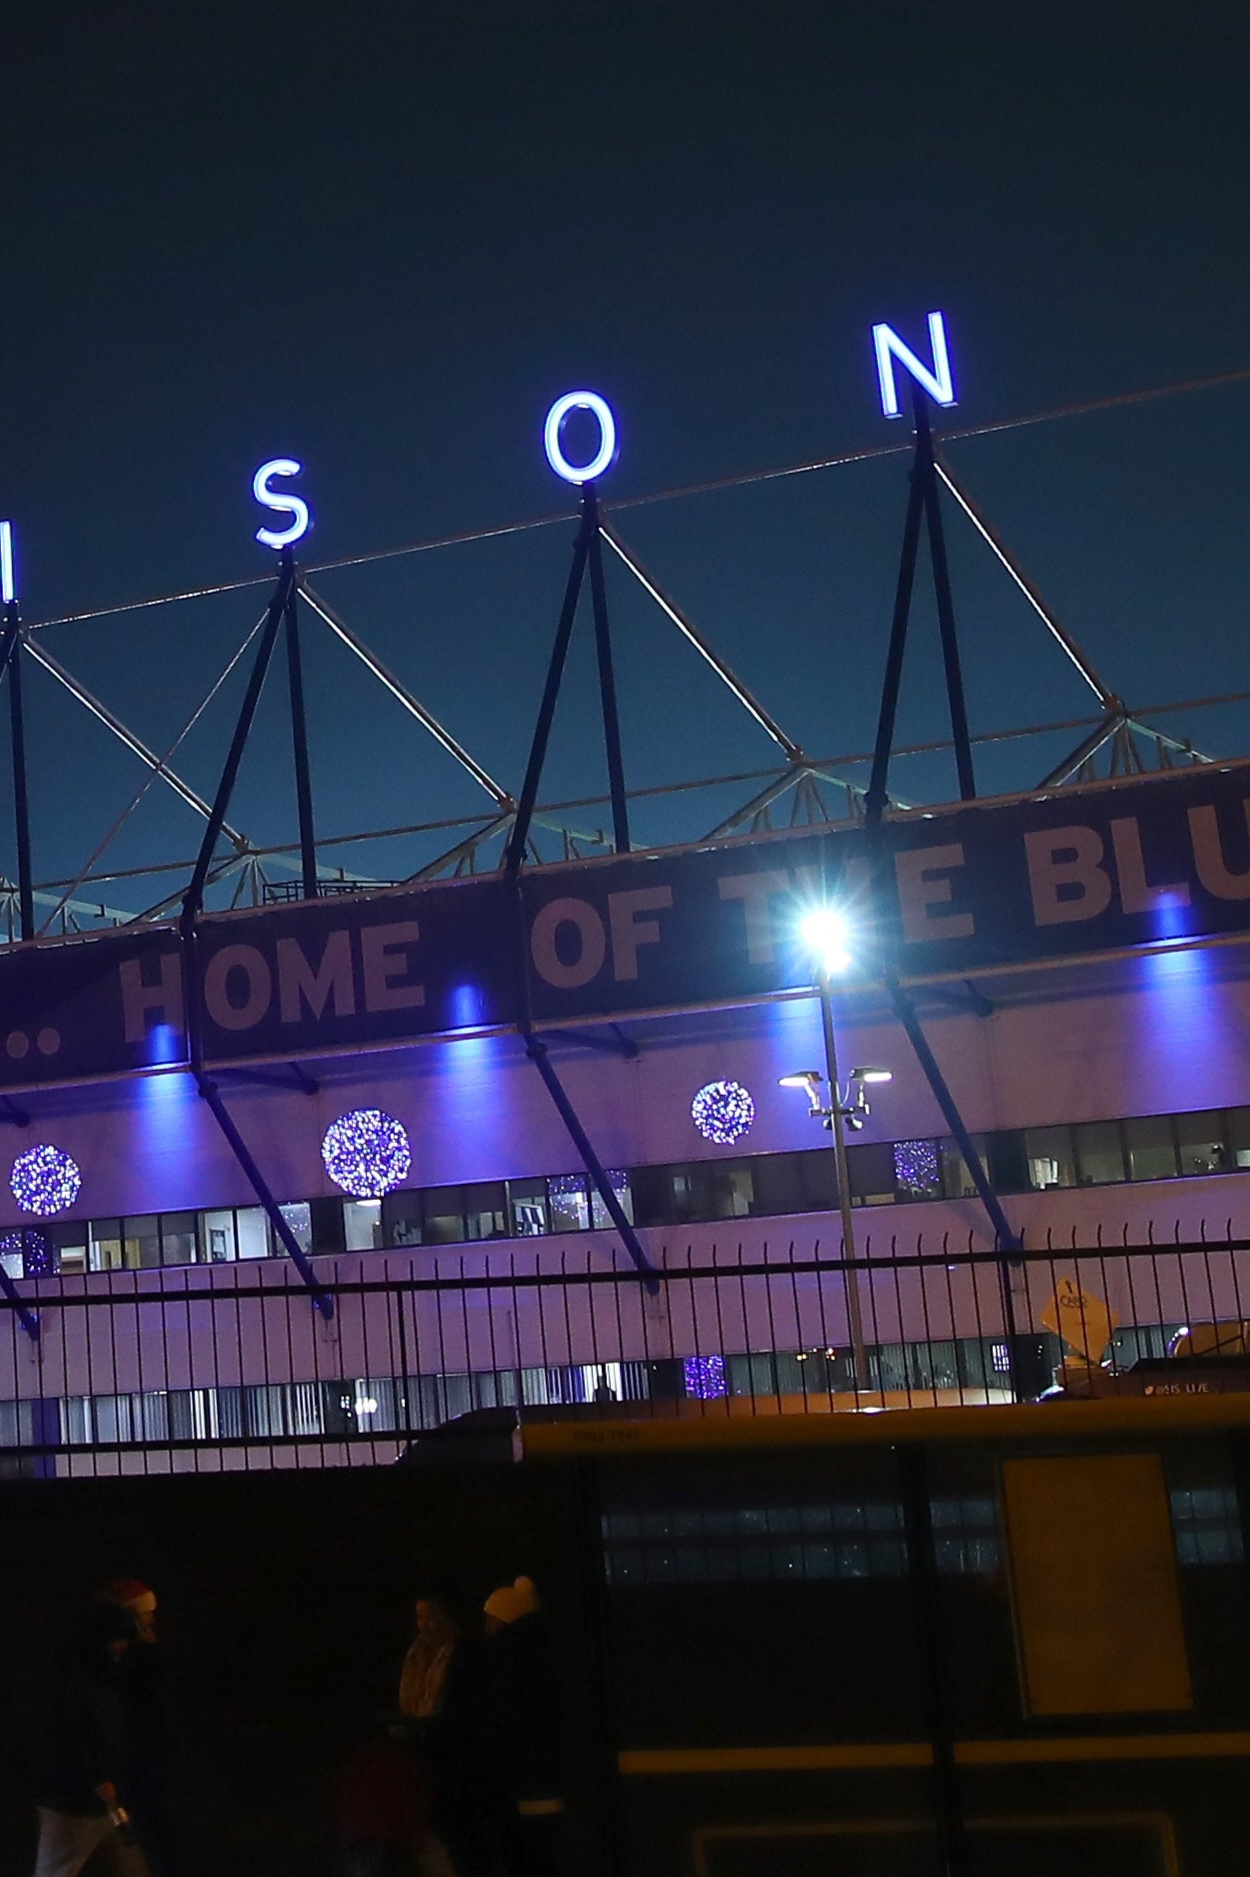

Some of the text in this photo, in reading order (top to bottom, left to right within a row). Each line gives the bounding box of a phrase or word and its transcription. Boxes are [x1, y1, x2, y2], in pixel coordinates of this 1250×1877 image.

[119, 920, 426, 1043] HOME
[530, 885, 675, 989] OF
[1024, 797, 1250, 927] BLU
